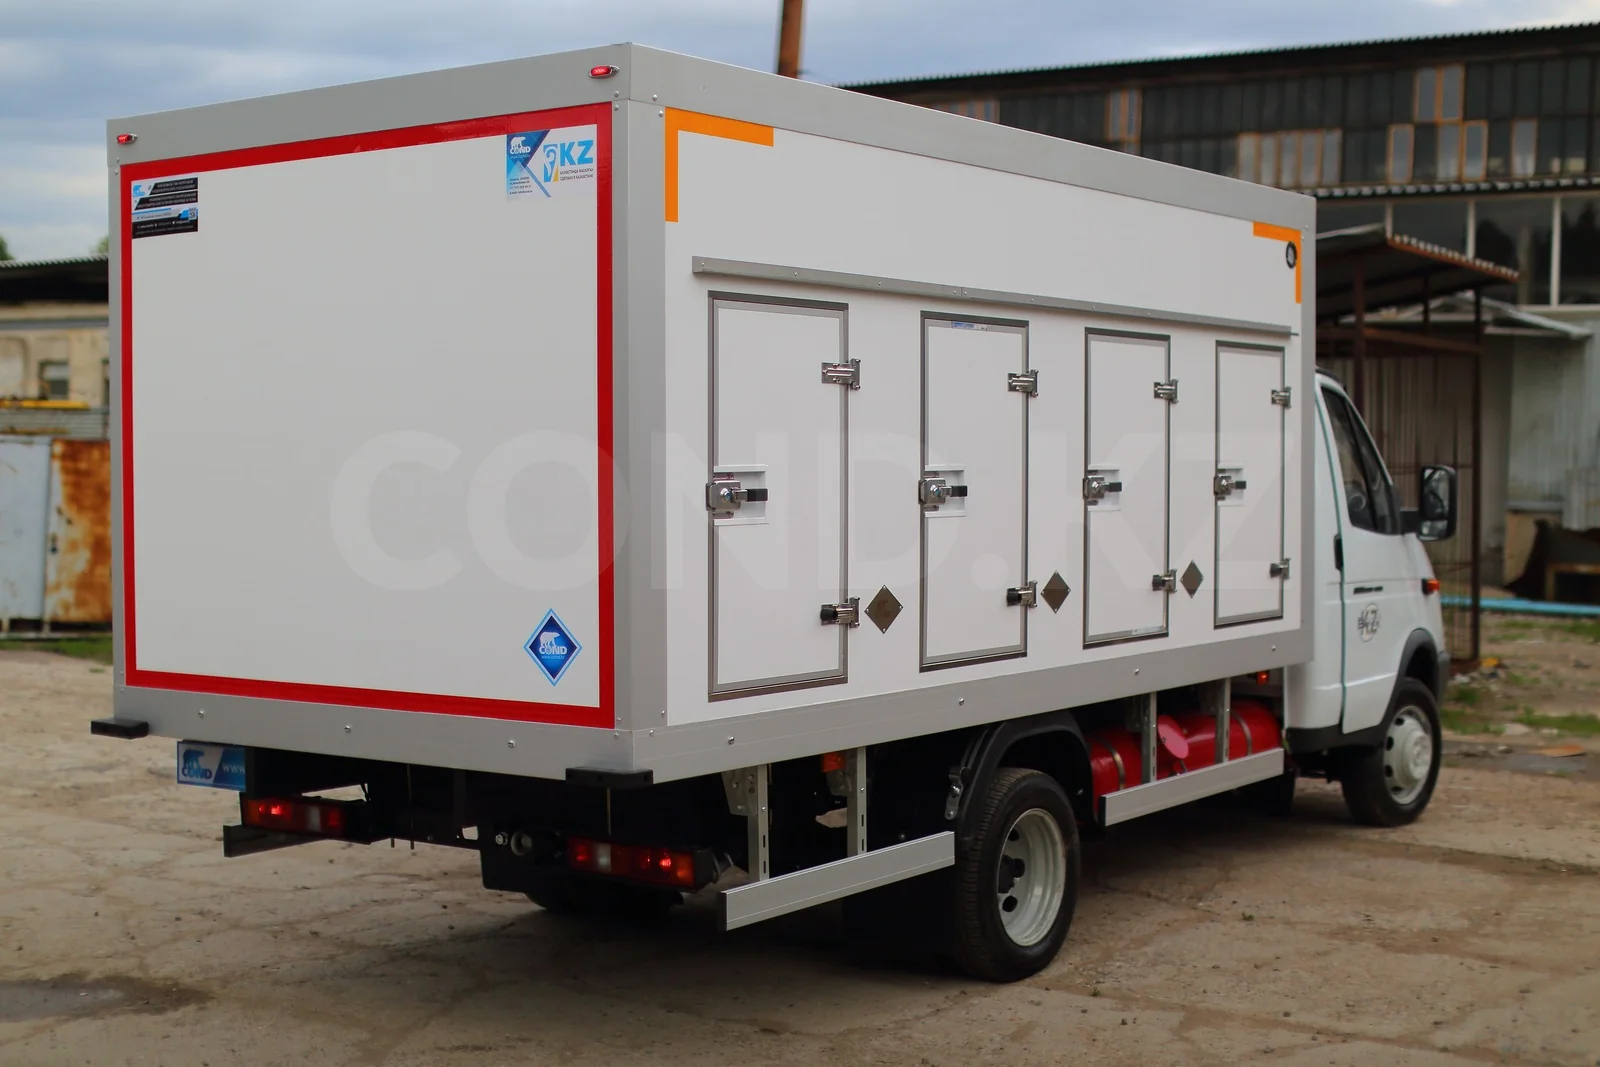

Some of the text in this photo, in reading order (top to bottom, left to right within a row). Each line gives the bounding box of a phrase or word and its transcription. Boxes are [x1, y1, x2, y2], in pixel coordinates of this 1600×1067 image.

[510, 146, 531, 154] COND
[560, 140, 594, 167] KZ
[539, 645, 568, 655] COND
